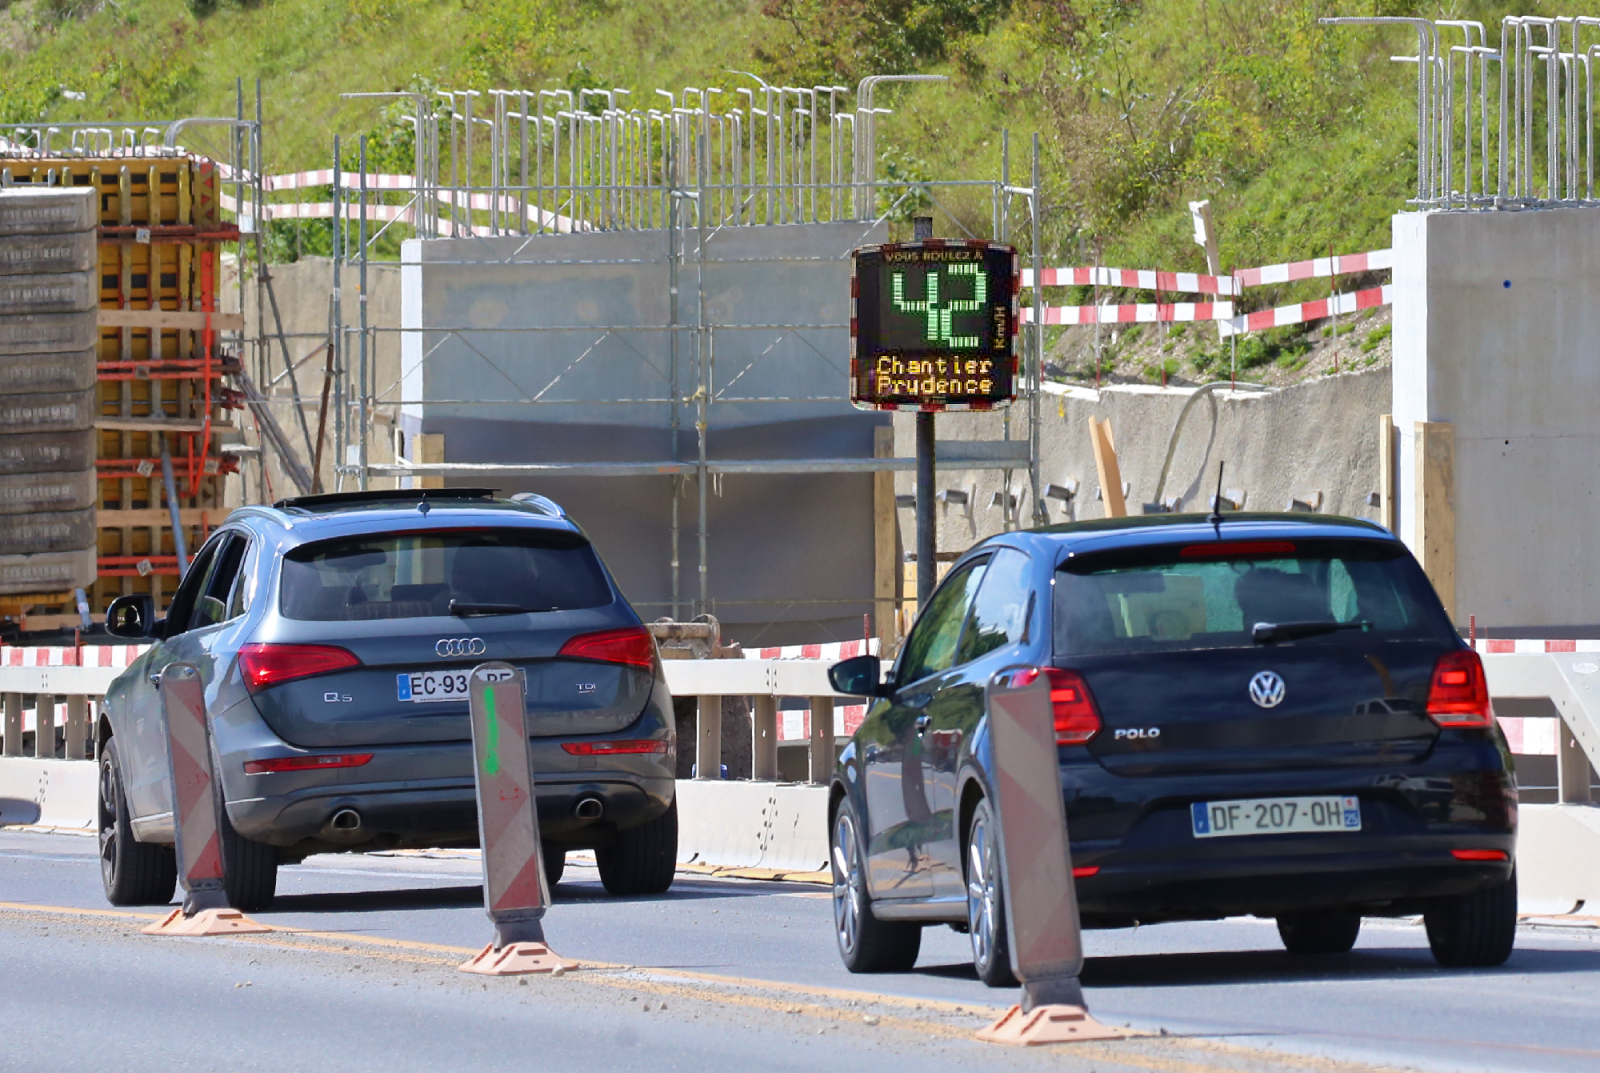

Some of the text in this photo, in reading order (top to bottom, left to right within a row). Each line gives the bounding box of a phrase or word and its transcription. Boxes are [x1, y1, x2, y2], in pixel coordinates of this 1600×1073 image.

[892, 262, 987, 348] 42
[876, 355, 993, 375] Chantier
[876, 376, 994, 395] Prudence
[323, 692, 353, 703] Q5
[1114, 727, 1161, 740] POLO
[1211, 801, 1341, 831] DF-207-QH
